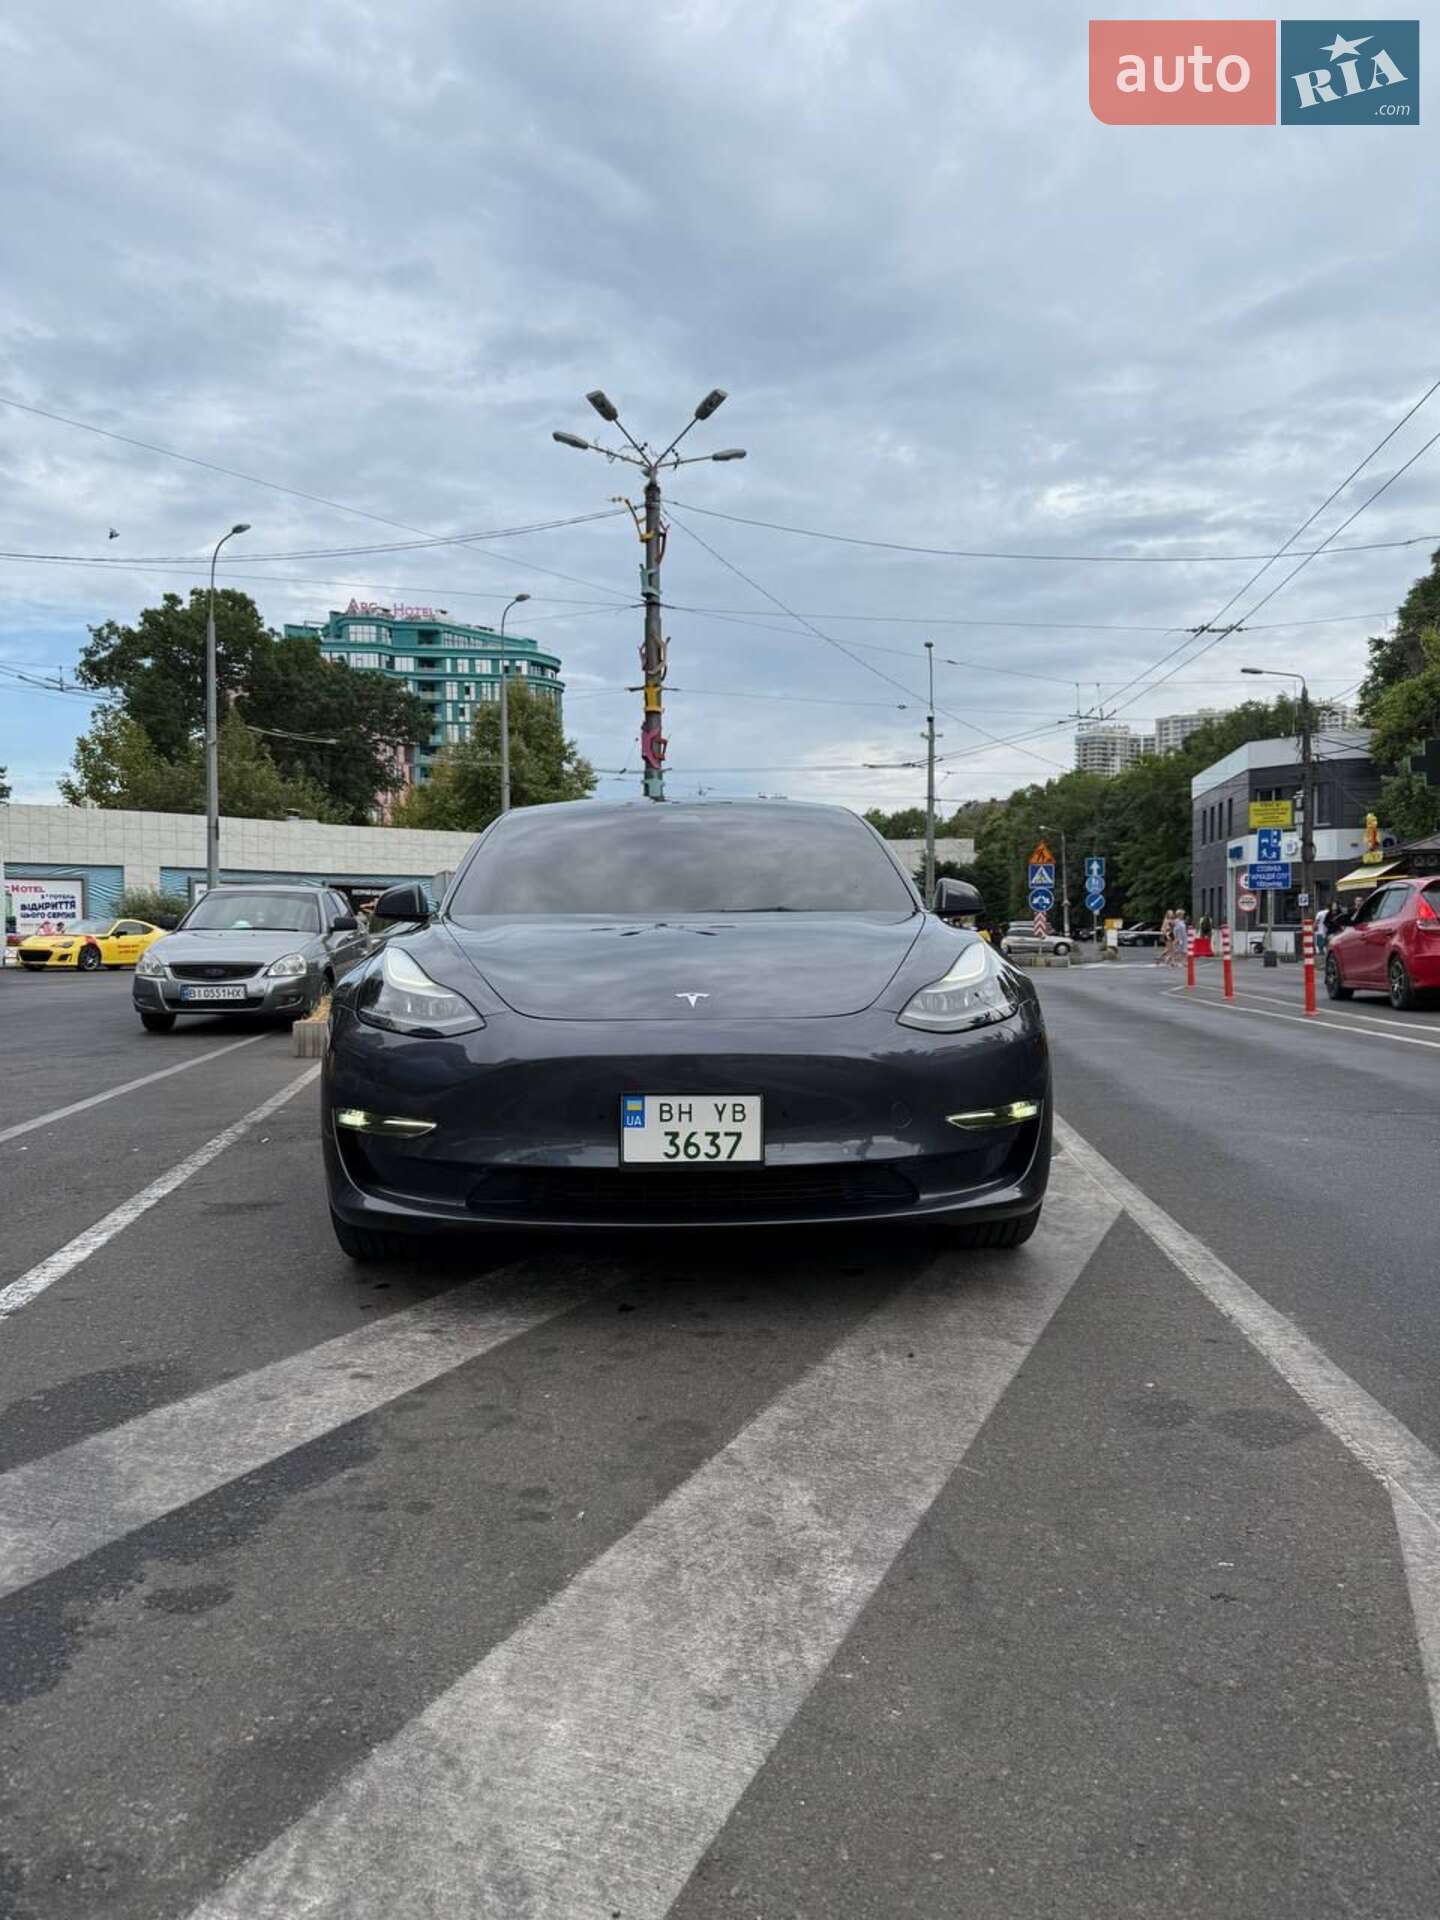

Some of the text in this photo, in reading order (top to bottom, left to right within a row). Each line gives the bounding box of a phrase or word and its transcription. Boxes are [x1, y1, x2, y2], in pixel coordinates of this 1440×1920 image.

[20, 900, 76, 911] ВІДКРИТТЯ
[659, 1103, 746, 1122] BH YB
[626, 1115, 643, 1126] UA
[663, 1131, 743, 1159] 3637
